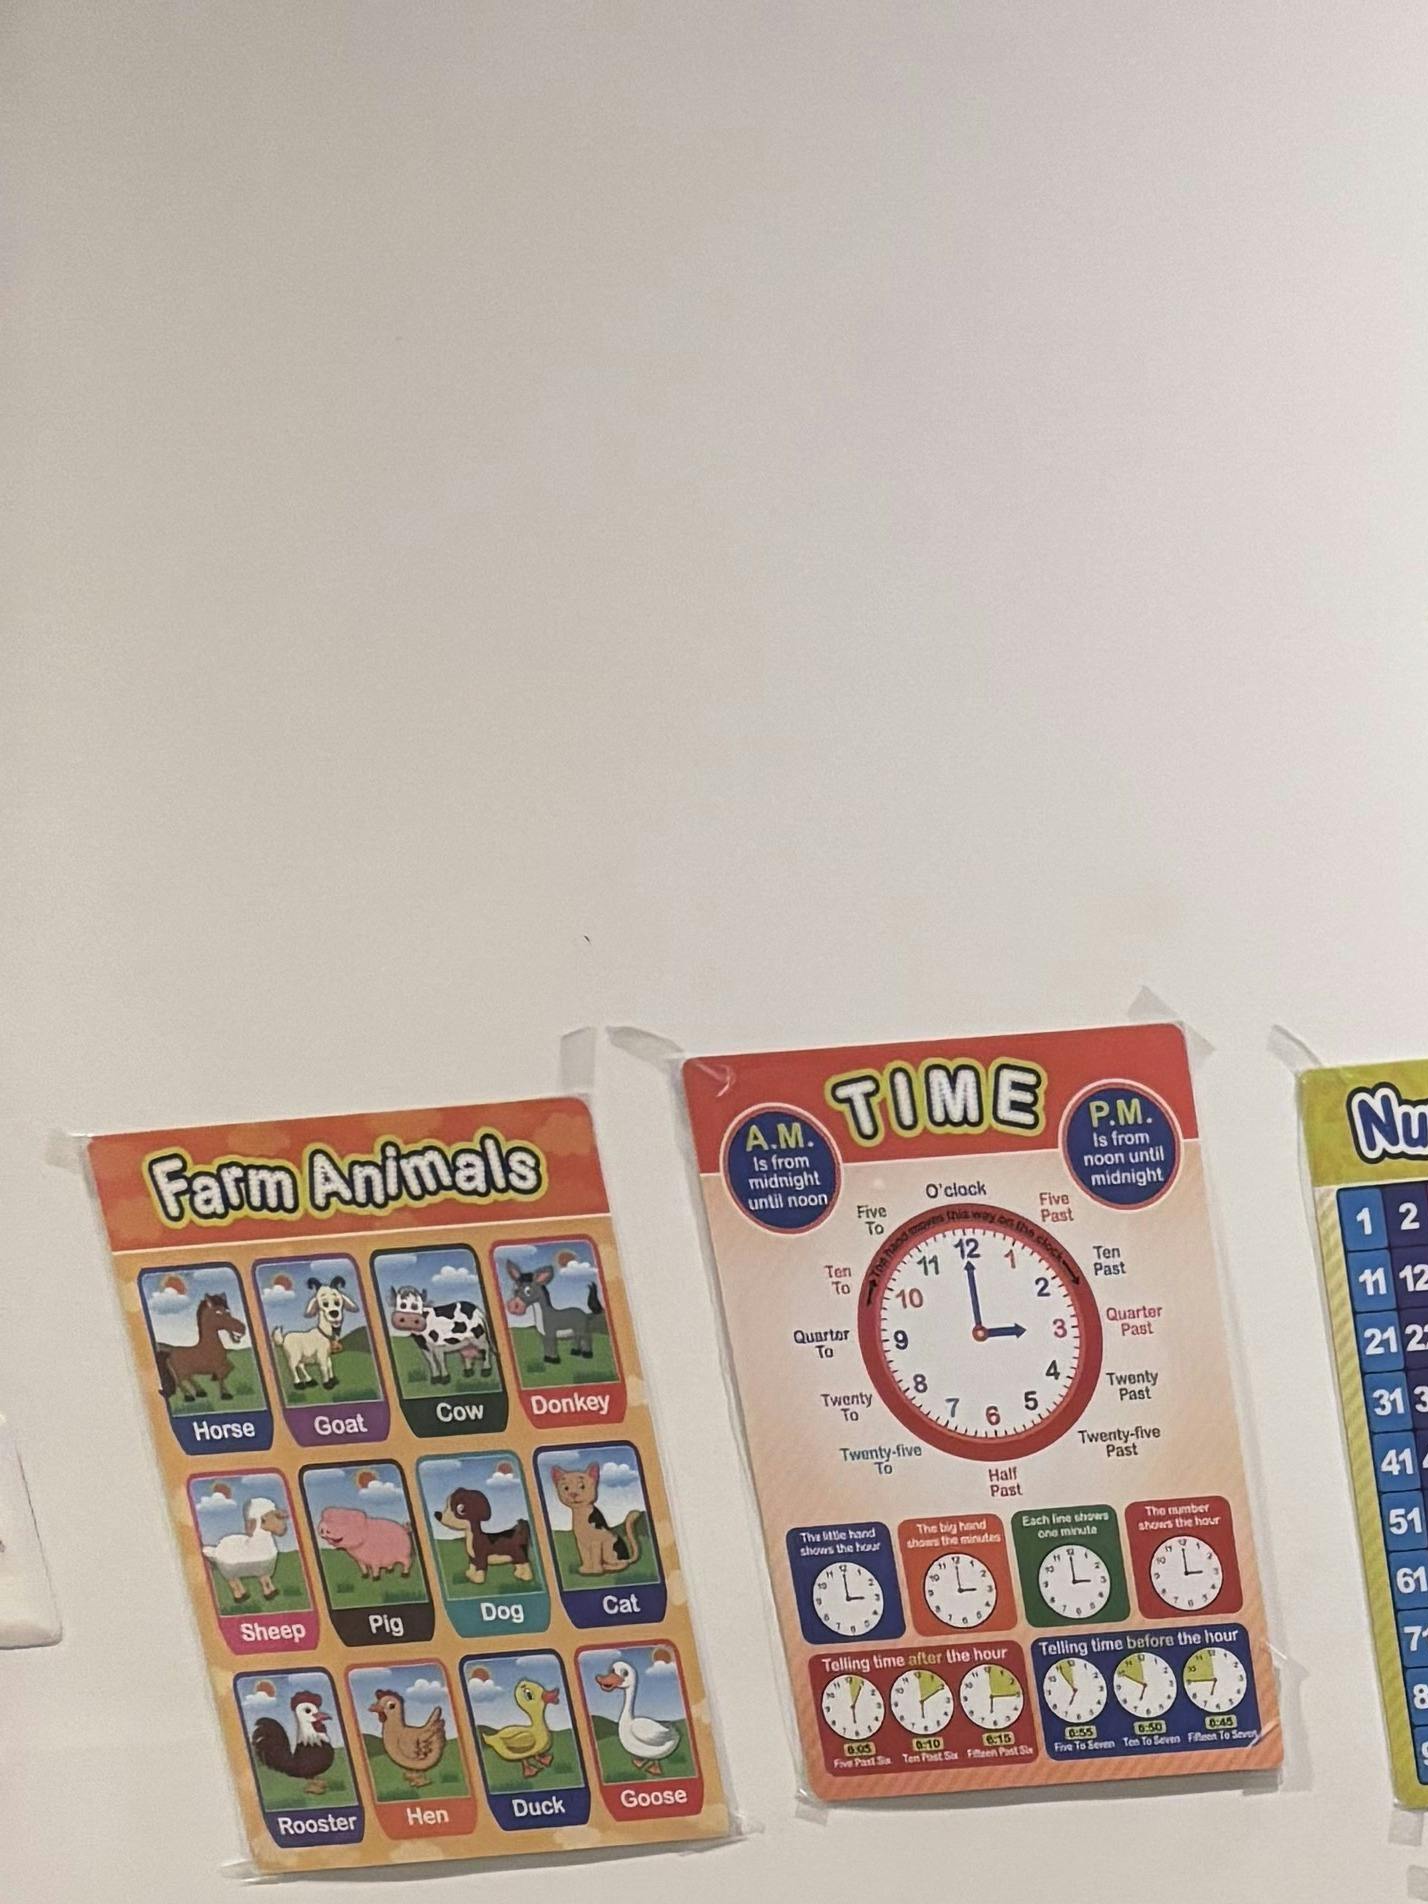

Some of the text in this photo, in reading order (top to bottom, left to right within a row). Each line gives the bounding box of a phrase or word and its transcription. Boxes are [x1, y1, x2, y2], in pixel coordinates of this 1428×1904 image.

[832, 1064, 1041, 1140] TIME
[1088, 1098, 1153, 1129] P.M.
[745, 1122, 814, 1152] A.M.
[1093, 1130, 1149, 1148] Is from
[753, 1155, 810, 1172] Is from
[1083, 1146, 1165, 1166] noon until
[149, 1133, 540, 1222] Farm Animals
[748, 1171, 821, 1191] midnight
[1091, 1167, 1165, 1188] midnight
[925, 1181, 987, 1198] O'clock
[1039, 1192, 1070, 1206] Five
[748, 1192, 828, 1211] until noon
[857, 1205, 887, 1219] Five
[1040, 1207, 1075, 1223] Past
[1356, 1207, 1373, 1235] 1
[1398, 1202, 1420, 1231] 2
[865, 1221, 885, 1236] To
[953, 1238, 981, 1259] 12
[1093, 1245, 1121, 1260] Ten
[917, 1255, 940, 1276] 11
[1003, 1249, 1017, 1269] 1
[1093, 1261, 1127, 1276] Past
[824, 1265, 851, 1279] Ten
[832, 1281, 851, 1295] To
[1034, 1277, 1051, 1297] 2
[895, 1288, 924, 1309] 10
[1106, 1305, 1163, 1322] Quarter
[793, 1329, 850, 1344] Quarter
[1052, 1318, 1068, 1338] 3
[1121, 1322, 1154, 1337] Past
[893, 1330, 909, 1350] 9
[815, 1345, 834, 1359] To
[1045, 1359, 1061, 1380] 4
[1105, 1370, 1159, 1386] Twenty
[912, 1373, 928, 1393] 8
[820, 1391, 873, 1409] Twenty
[1024, 1390, 1039, 1411] 5
[1119, 1386, 1152, 1401] Past
[435, 1402, 484, 1423] Cow
[531, 1392, 611, 1416] Donkey
[945, 1397, 960, 1417] 7
[313, 1412, 368, 1436] Goat
[841, 1407, 859, 1422] To
[985, 1406, 1001, 1426] 6
[193, 1420, 256, 1442] Horse
[1078, 1425, 1161, 1444] Twenty-five
[839, 1444, 922, 1463] Twenty-five
[1105, 1443, 1139, 1458] Past
[874, 1462, 893, 1475] To
[988, 1466, 1018, 1482] Half
[989, 1483, 1023, 1498] Past
[480, 1601, 525, 1624] Dog
[601, 1594, 641, 1616] Cat
[240, 1621, 307, 1645] Sheep
[368, 1613, 405, 1637] Pig
[1039, 1628, 1239, 1657] Telling time before the hour
[822, 1647, 1008, 1673] Telling time after the hour
[512, 1796, 566, 1818] Duck
[620, 1787, 688, 1809] Goose
[277, 1813, 358, 1838] Rooster
[407, 1807, 449, 1826] Hen
